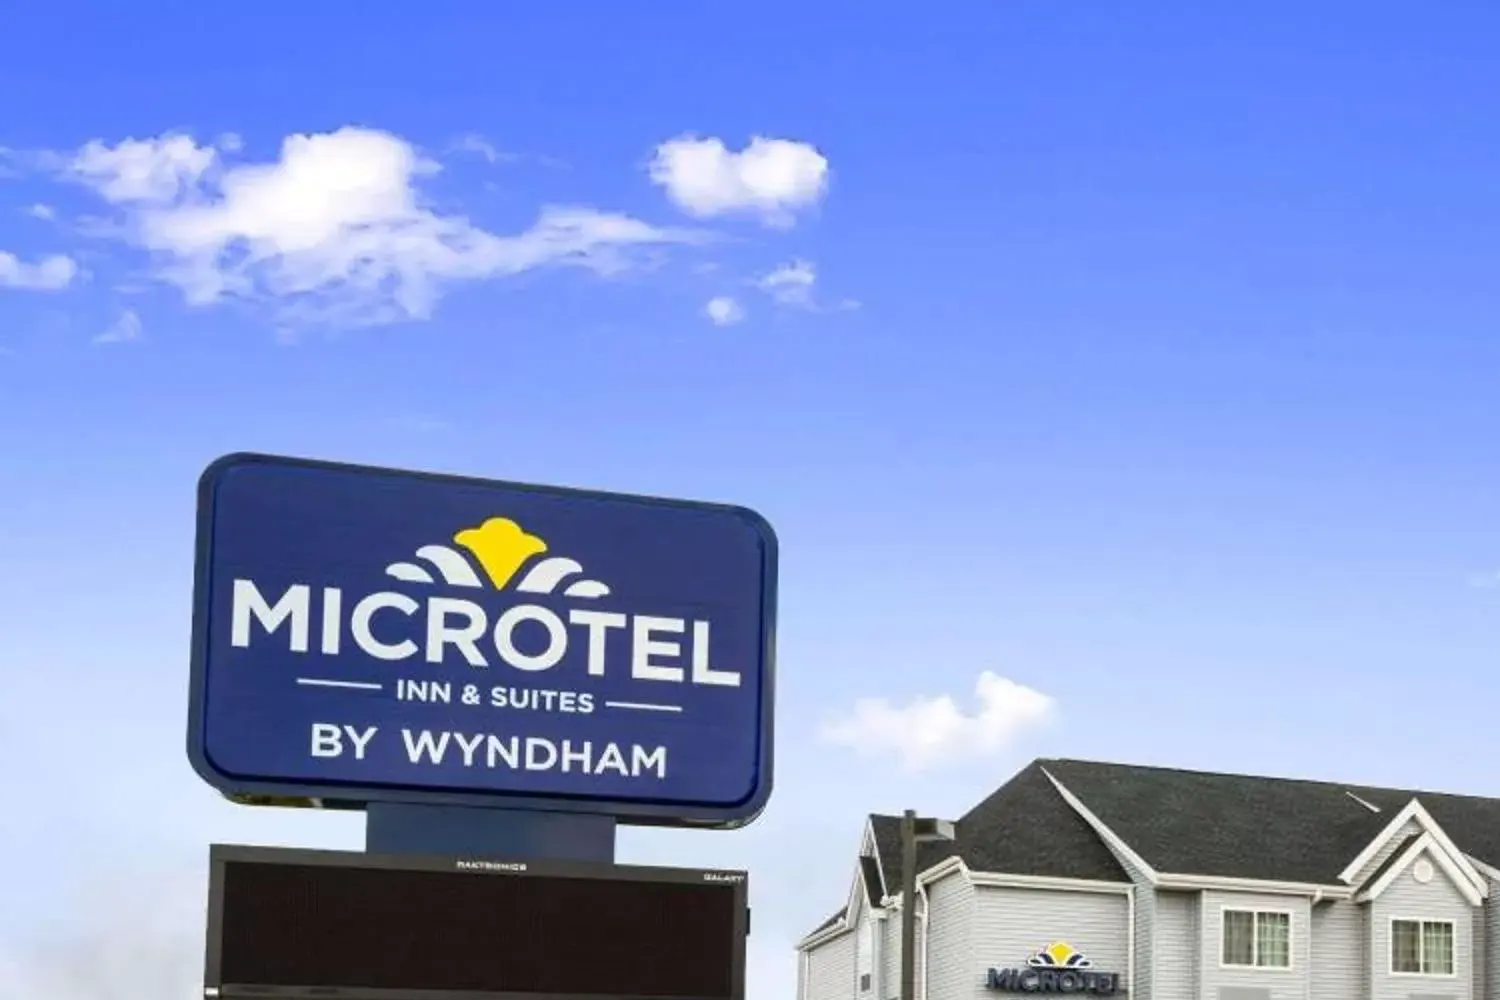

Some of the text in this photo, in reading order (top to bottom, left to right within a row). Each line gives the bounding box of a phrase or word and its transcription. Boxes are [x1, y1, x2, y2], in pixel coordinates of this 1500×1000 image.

[230, 579, 742, 687] MICROTEL
[397, 679, 594, 713] INN & SUITES
[310, 724, 667, 779] BY WYNDHAM
